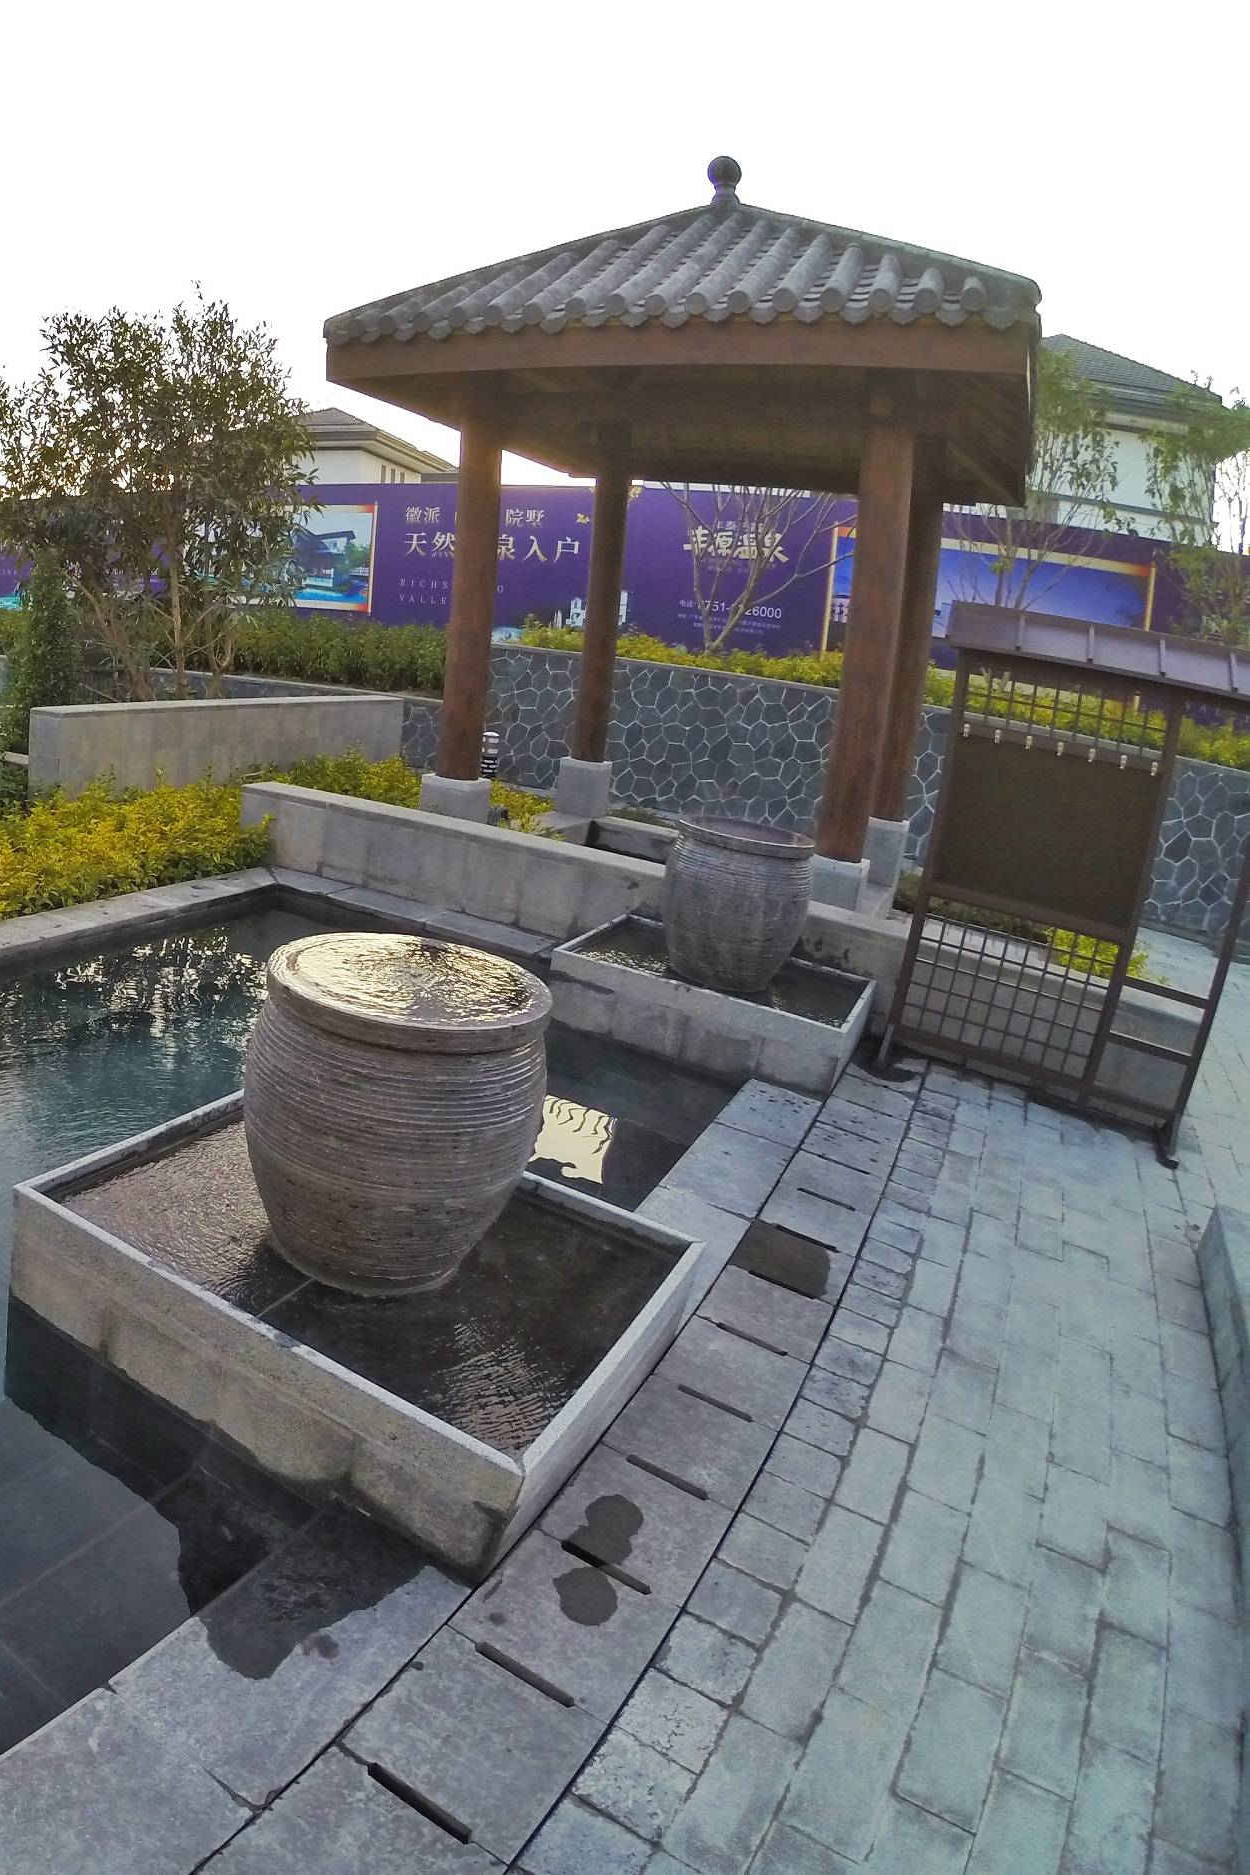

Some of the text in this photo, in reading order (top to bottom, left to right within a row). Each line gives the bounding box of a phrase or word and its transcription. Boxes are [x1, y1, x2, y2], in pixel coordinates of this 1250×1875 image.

[403, 531, 580, 563] 天然泉入户
